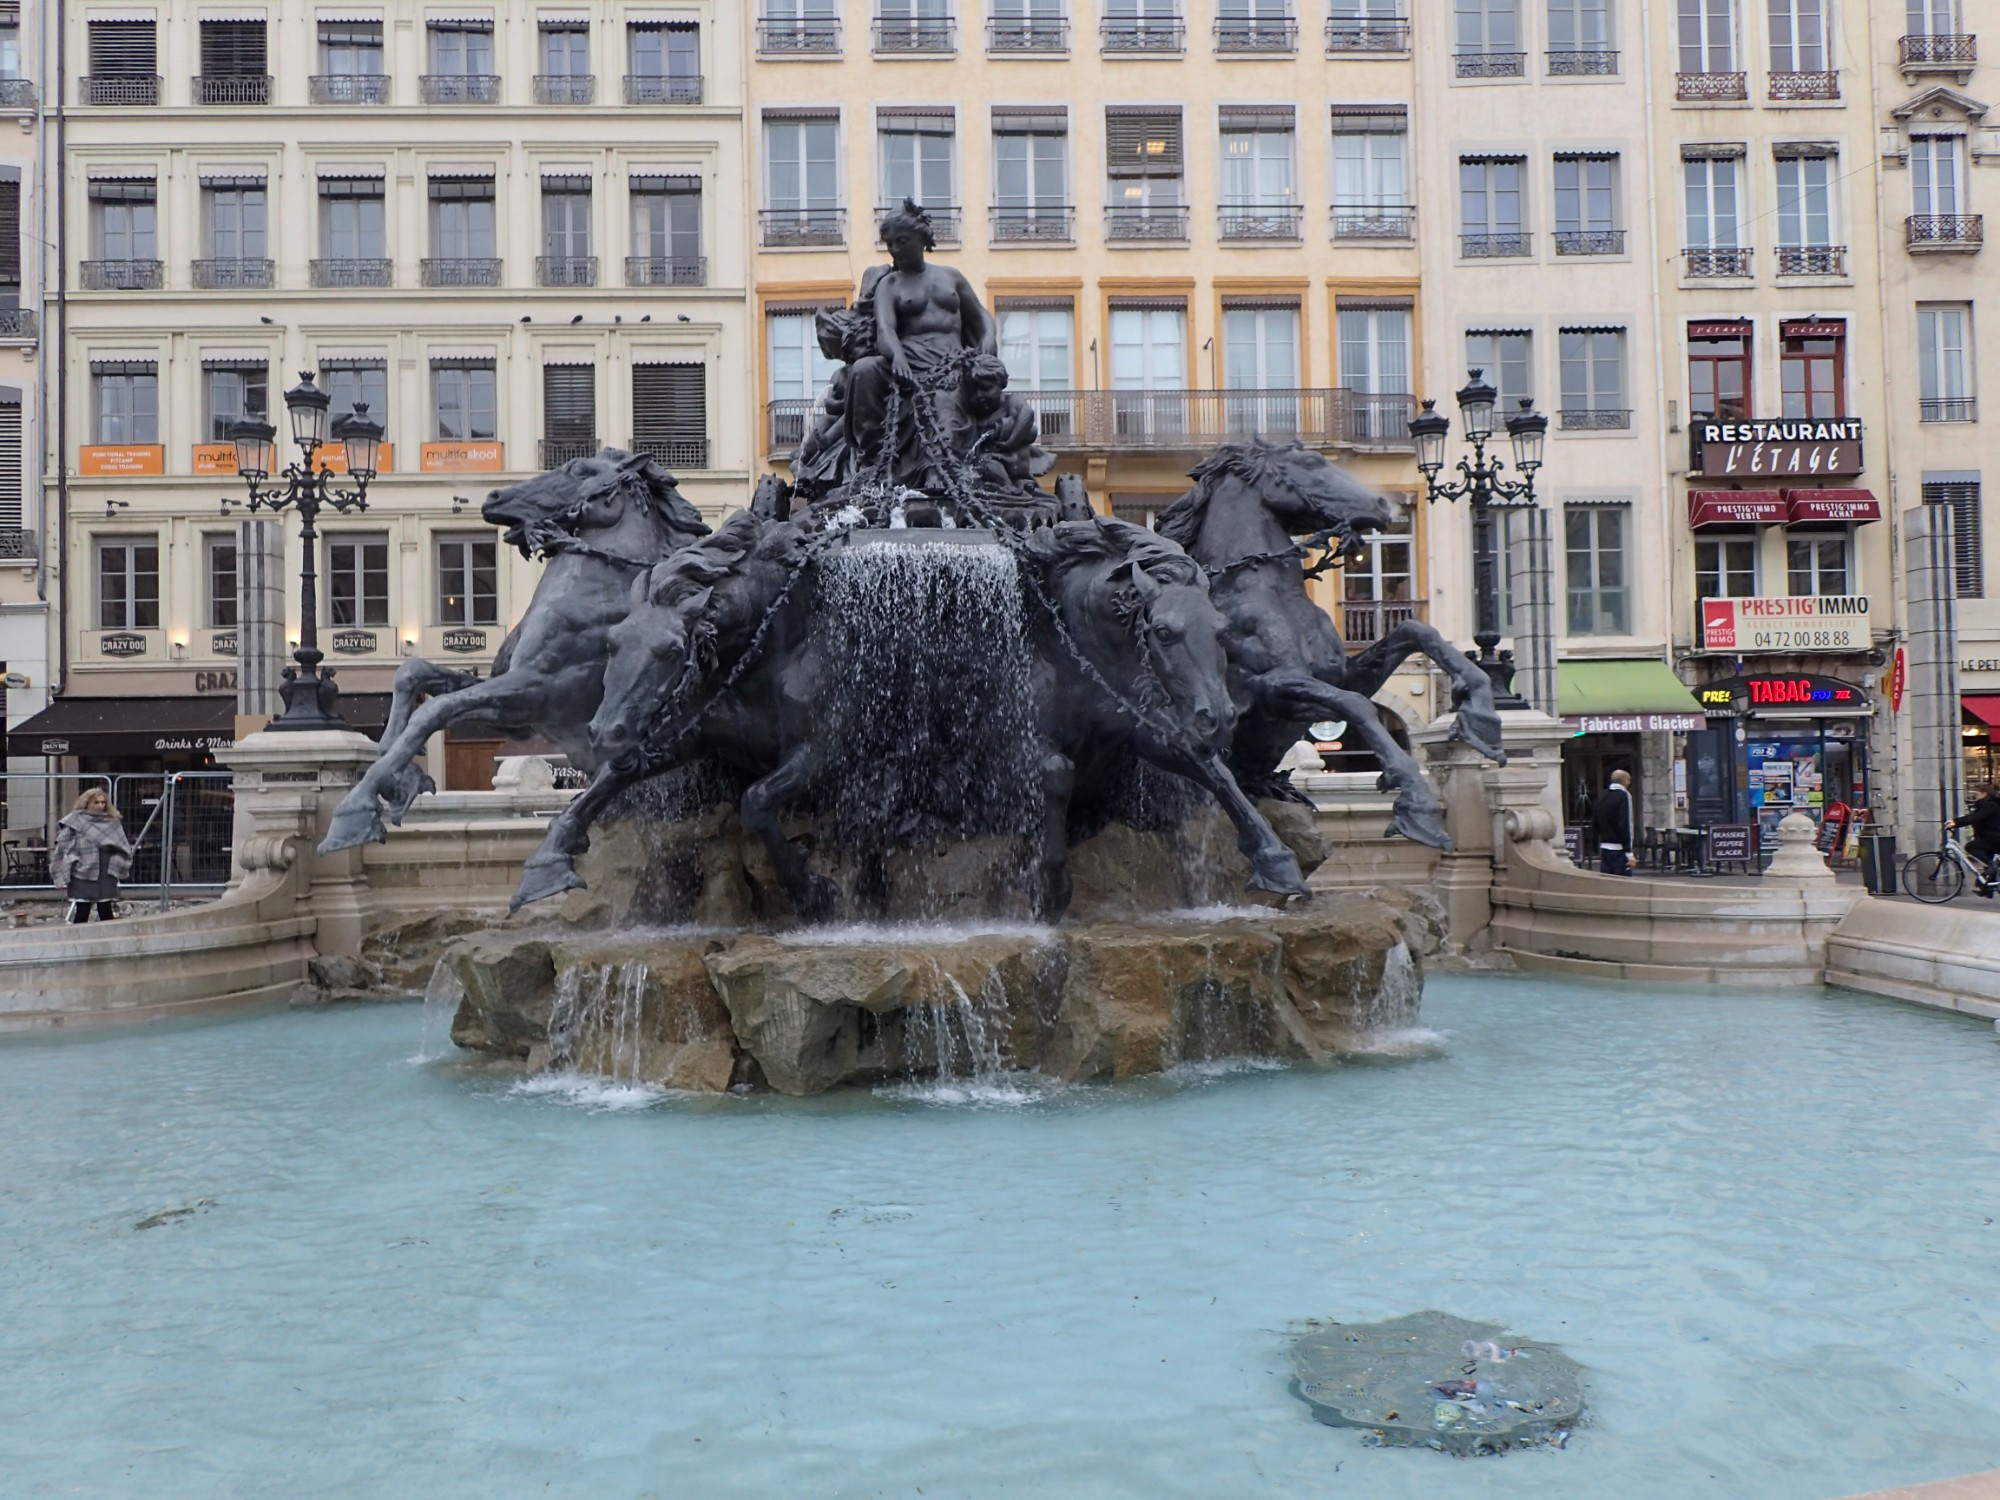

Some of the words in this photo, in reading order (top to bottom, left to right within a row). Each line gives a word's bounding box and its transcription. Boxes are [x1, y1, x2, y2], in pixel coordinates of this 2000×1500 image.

[1705, 423, 1860, 442] RESTAURANT
[426, 448, 497, 459] multifaskool
[1726, 442, 1839, 473] L'ÉTAGE
[1717, 505, 1776, 513] PRESTIG'IMMO
[1810, 503, 1870, 511] PRESTIG'IMMO
[1735, 512, 1761, 520] VENTE
[1828, 510, 1854, 518] ACHAT
[1742, 597, 1868, 616] PRESTIG'IMMO
[333, 638, 358, 649] CRAZY
[360, 638, 376, 648] DOG
[442, 636, 469, 647] CRAZY
[469, 636, 486, 646] DOG
[1706, 636, 1733, 644] IMMO
[1755, 632, 1771, 647] 04
[1775, 632, 1790, 647] 72
[1794, 631, 1810, 646] 00
[1814, 631, 1830, 646] 88
[1833, 630, 1849, 646] 88
[102, 640, 128, 651] CRAZY
[129, 640, 146, 651] DOG
[1961, 659, 1974, 671] LE
[1749, 680, 1811, 702] TABAC
[1581, 716, 1642, 731] Fabricant
[1650, 715, 1695, 730] Glacier
[155, 738, 192, 749] Drinks
[195, 738, 205, 748] &
[1713, 831, 1746, 839] BRASSERIE
